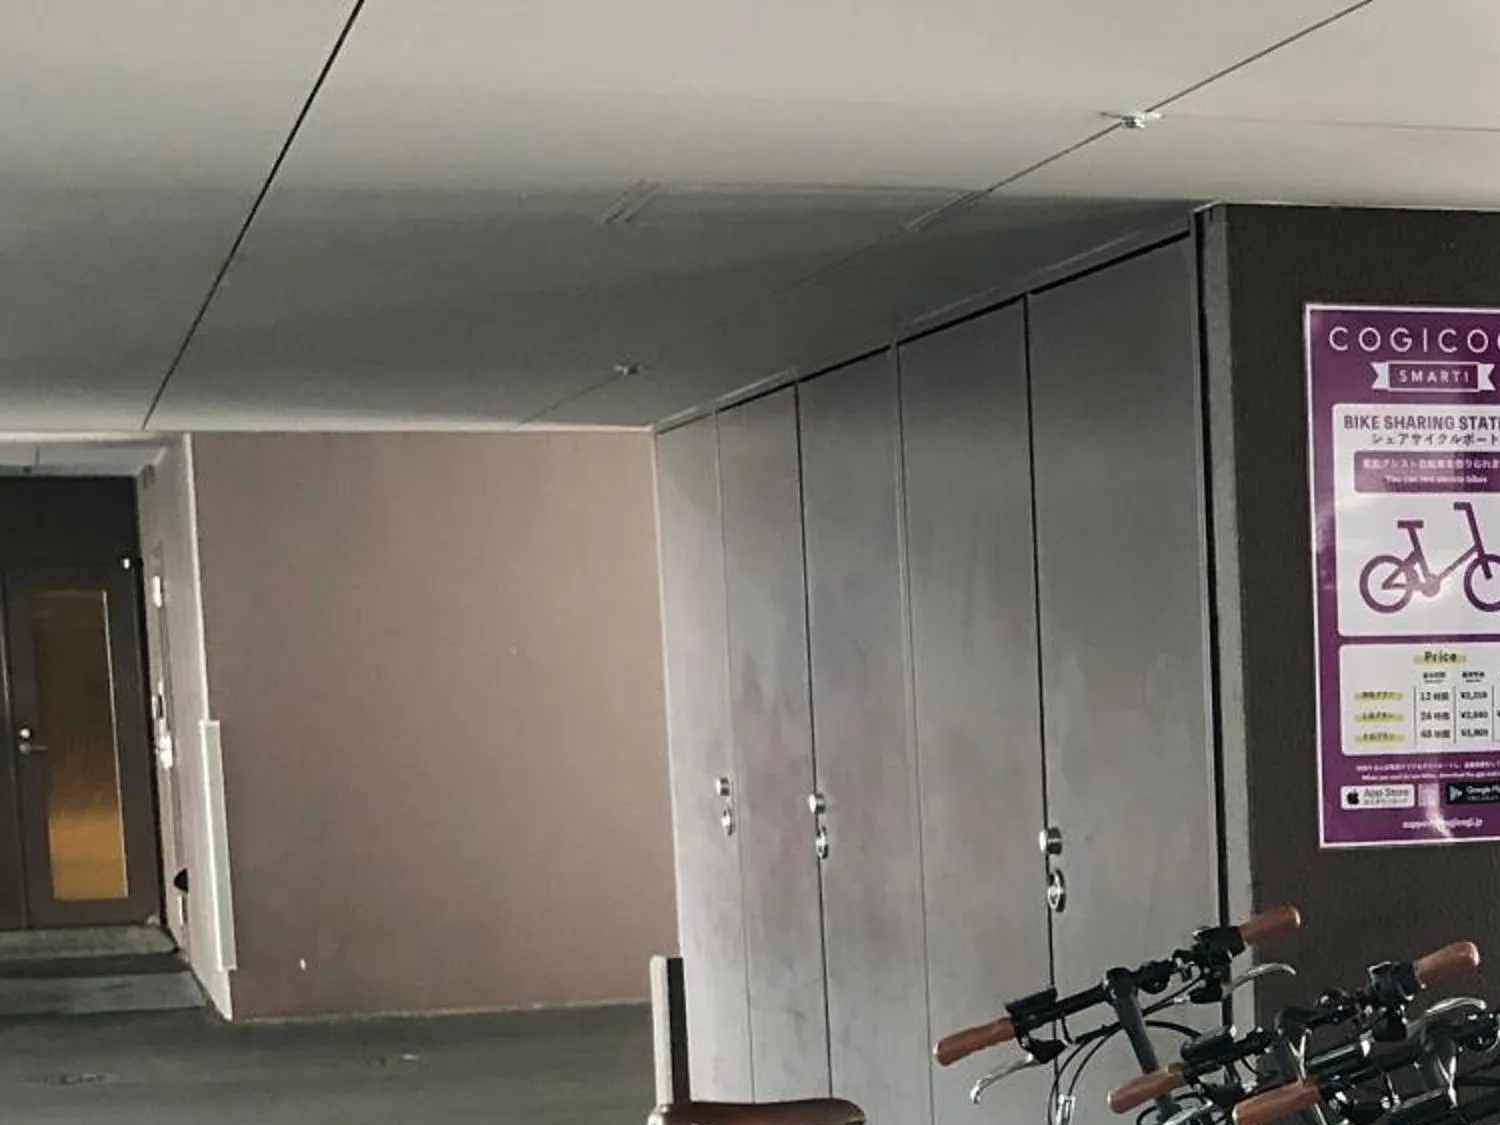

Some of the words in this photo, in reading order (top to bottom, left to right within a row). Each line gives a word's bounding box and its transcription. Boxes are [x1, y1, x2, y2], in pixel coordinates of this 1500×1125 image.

[1343, 415, 1380, 431] BIKE
[1383, 415, 1455, 431] SHARING
[1371, 432, 1500, 447] シェアサイクルポート
[1423, 650, 1457, 663] Price
[1363, 788, 1381, 799] App
[1383, 787, 1409, 798] Store
[1465, 785, 1491, 796] Google
